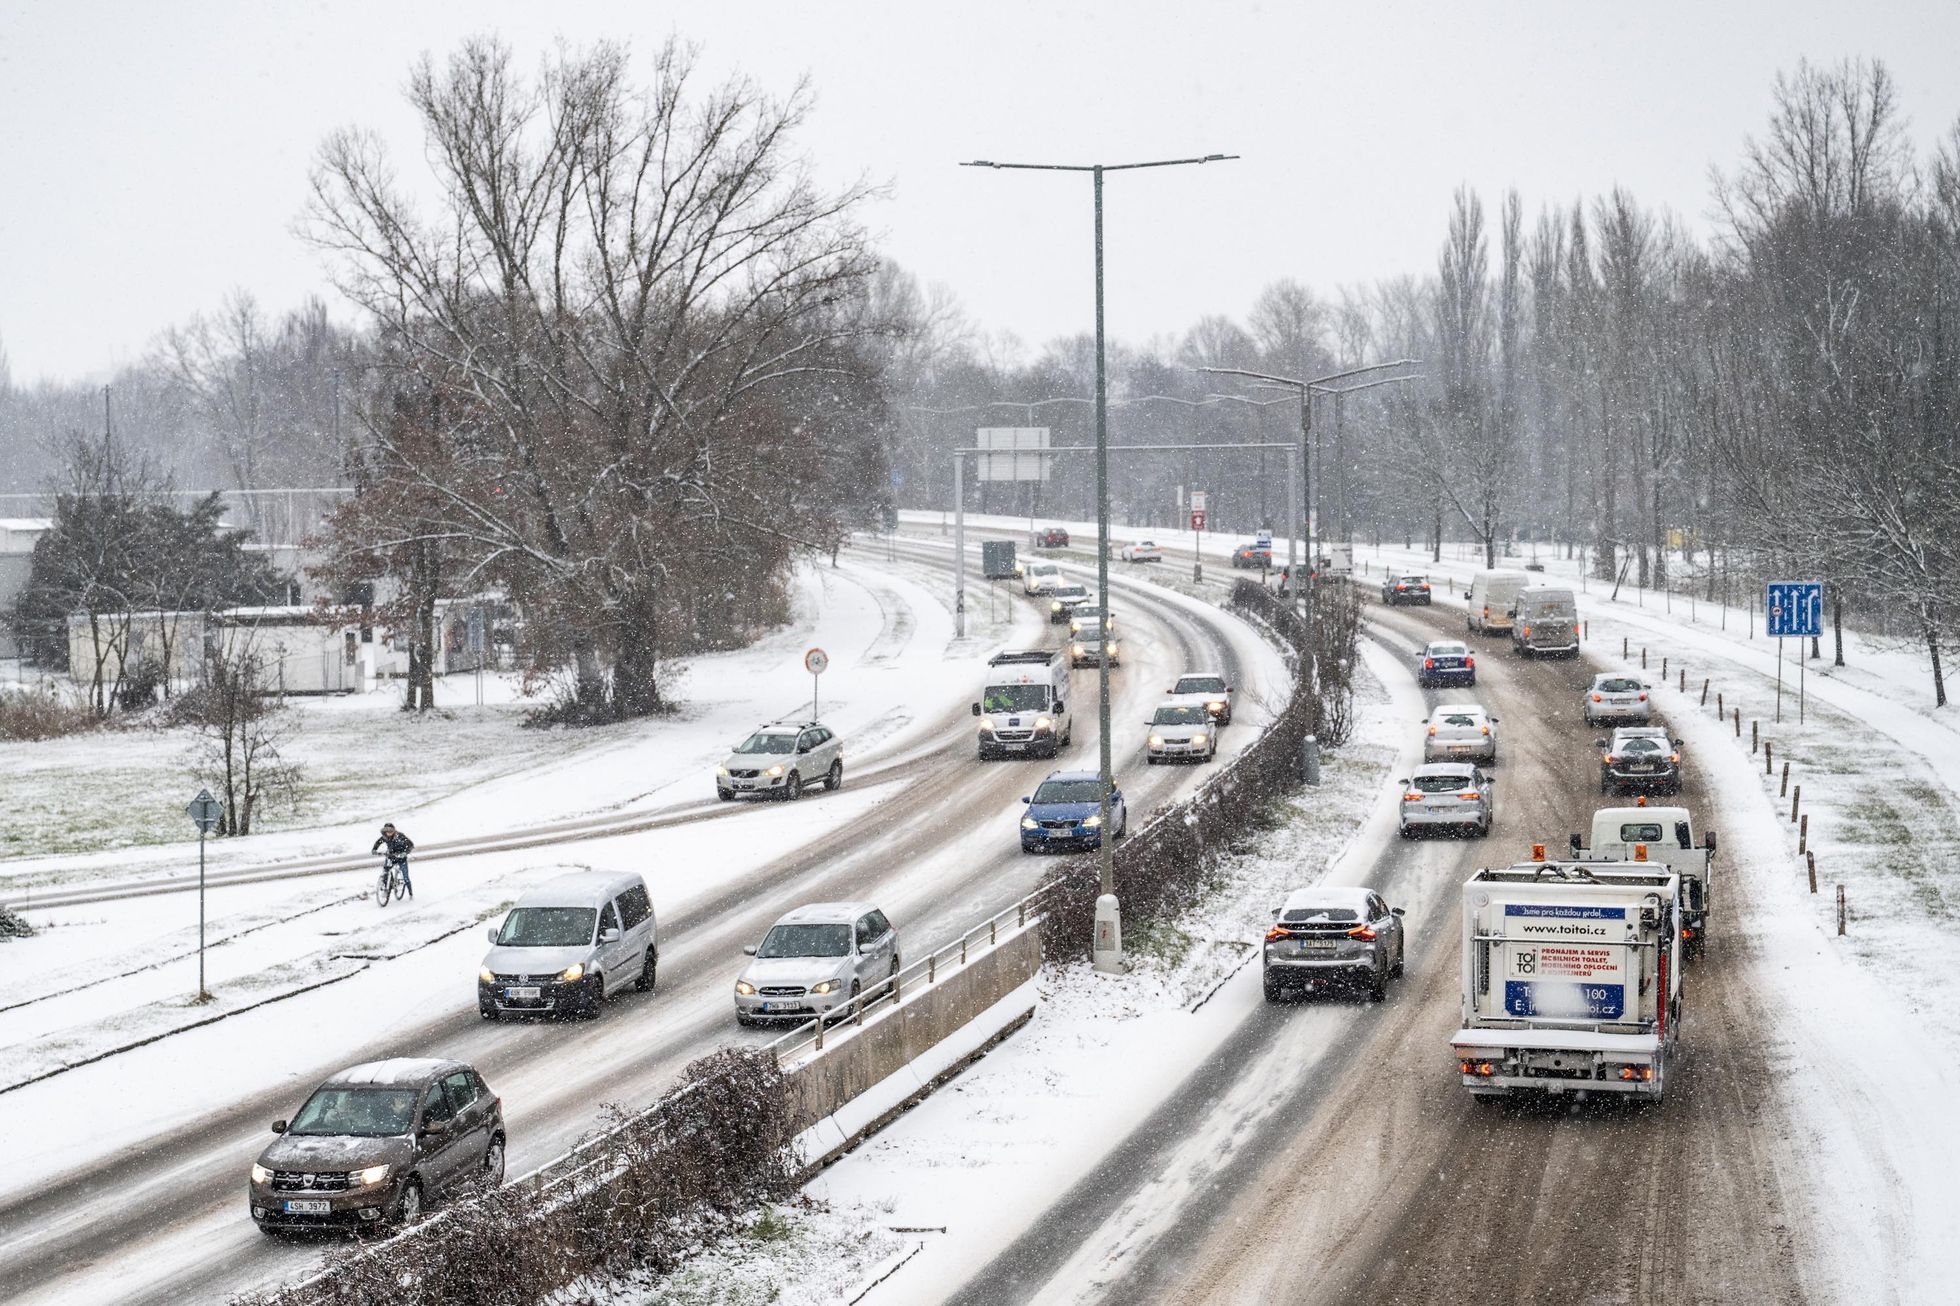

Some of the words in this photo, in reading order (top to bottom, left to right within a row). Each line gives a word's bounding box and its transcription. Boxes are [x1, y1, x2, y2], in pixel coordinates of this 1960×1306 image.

[1541, 908, 1554, 916] pro
[1555, 908, 1581, 917] každou
[1523, 924, 1606, 935] www.toitoi.cz
[1517, 963, 1536, 974] TOI
[1585, 988, 1607, 1000] 100
[1515, 999, 1525, 1011] E:
[309, 1202, 327, 1211] 3972
